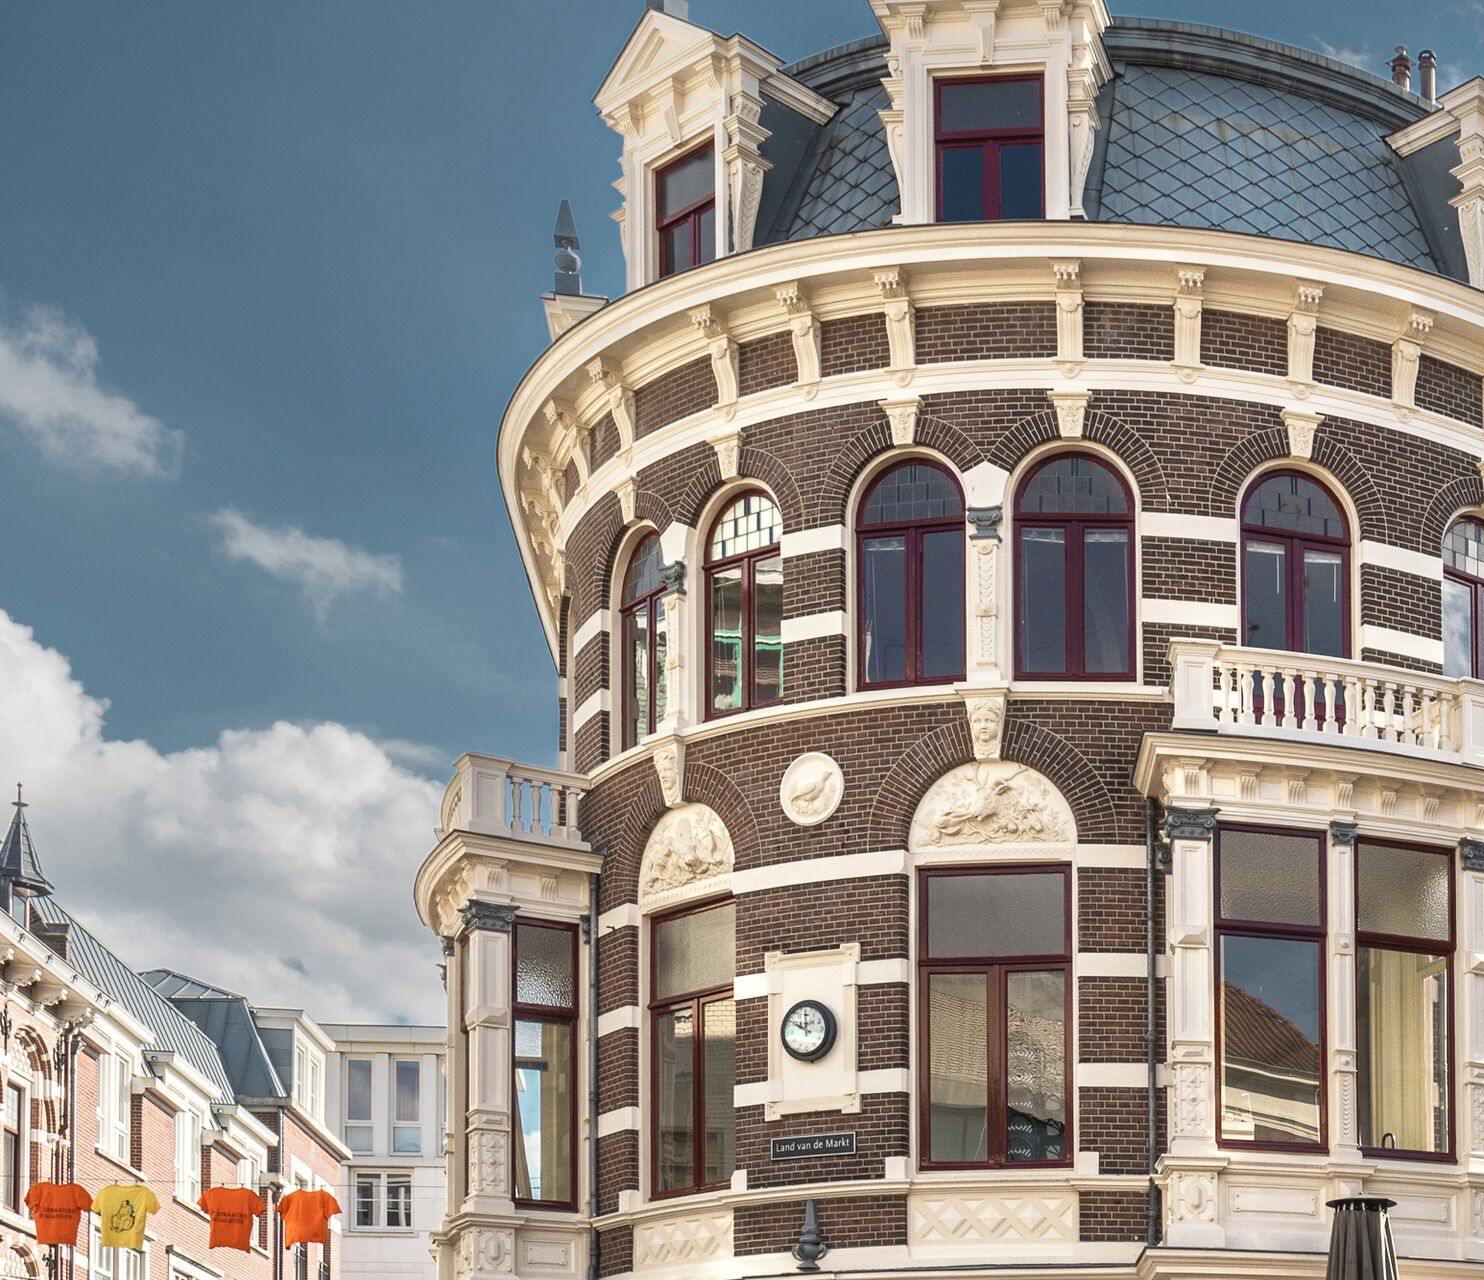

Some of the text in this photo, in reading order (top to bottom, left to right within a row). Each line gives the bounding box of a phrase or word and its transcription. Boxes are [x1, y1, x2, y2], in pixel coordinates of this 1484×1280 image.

[776, 1137, 850, 1153] Land van de Markt
